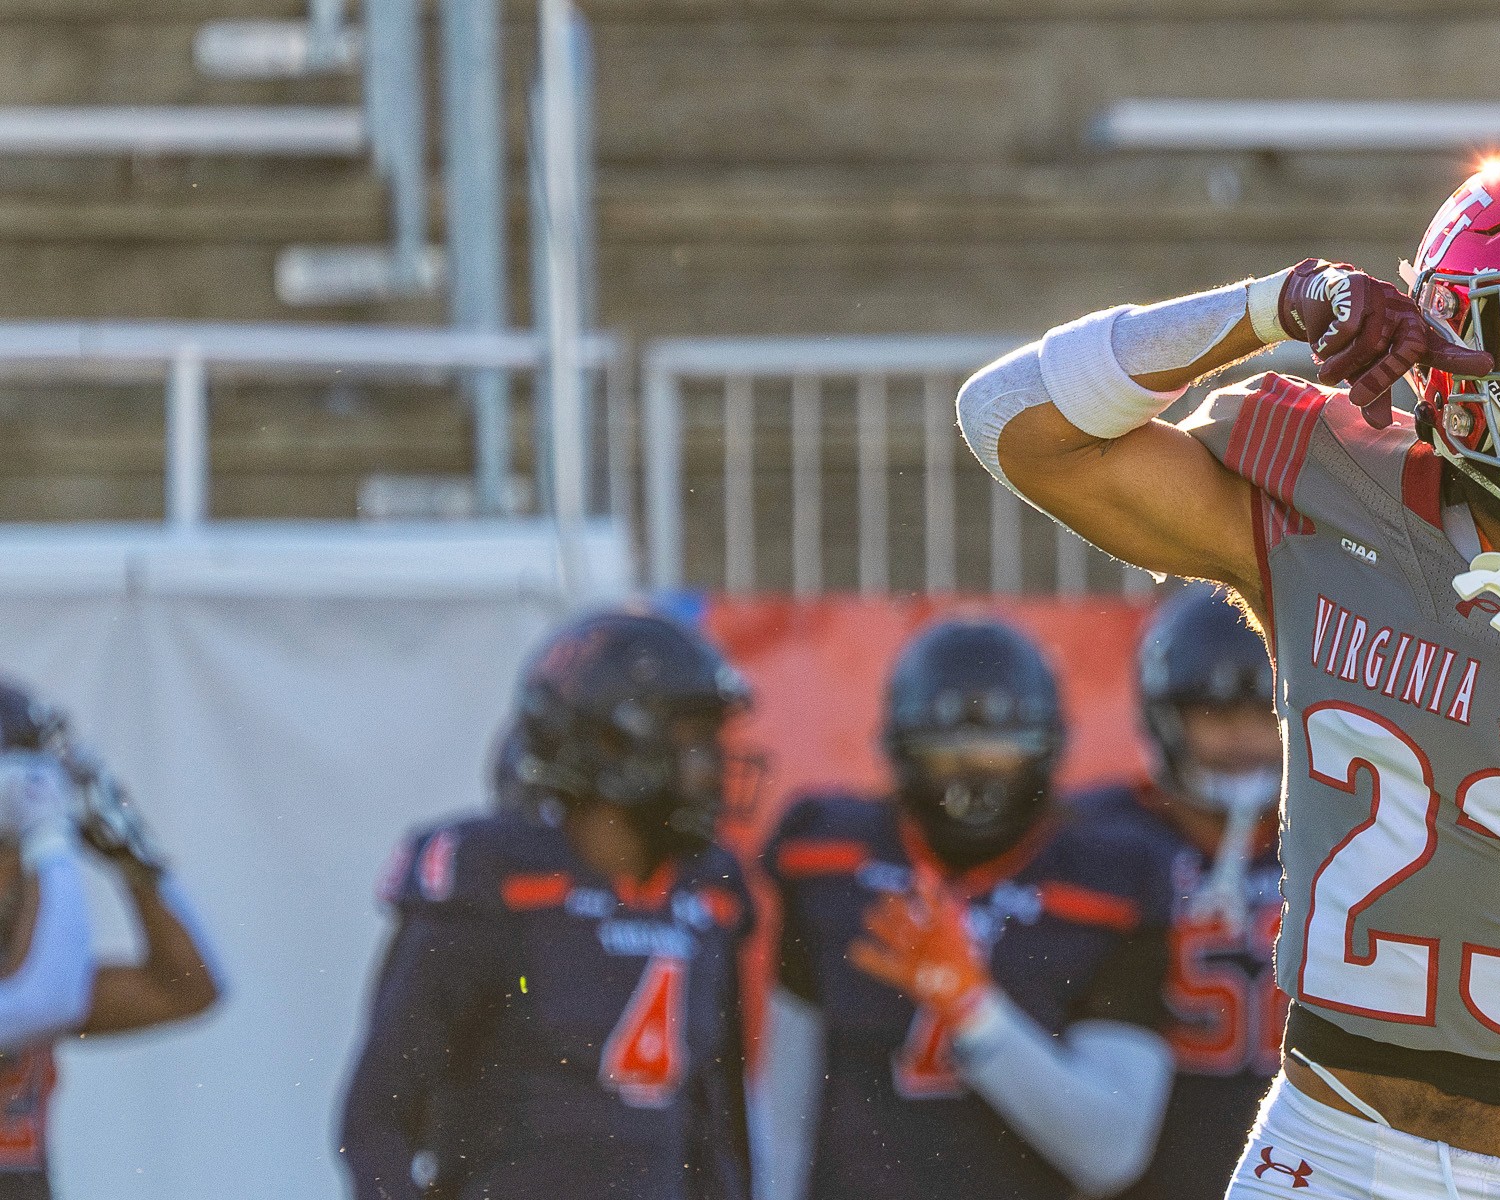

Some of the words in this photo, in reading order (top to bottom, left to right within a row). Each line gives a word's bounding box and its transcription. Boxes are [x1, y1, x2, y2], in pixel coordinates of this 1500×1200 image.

[1341, 537, 1377, 565] CIAA
[1310, 594, 1481, 726] VIRGINIA
[600, 955, 688, 1108] 4
